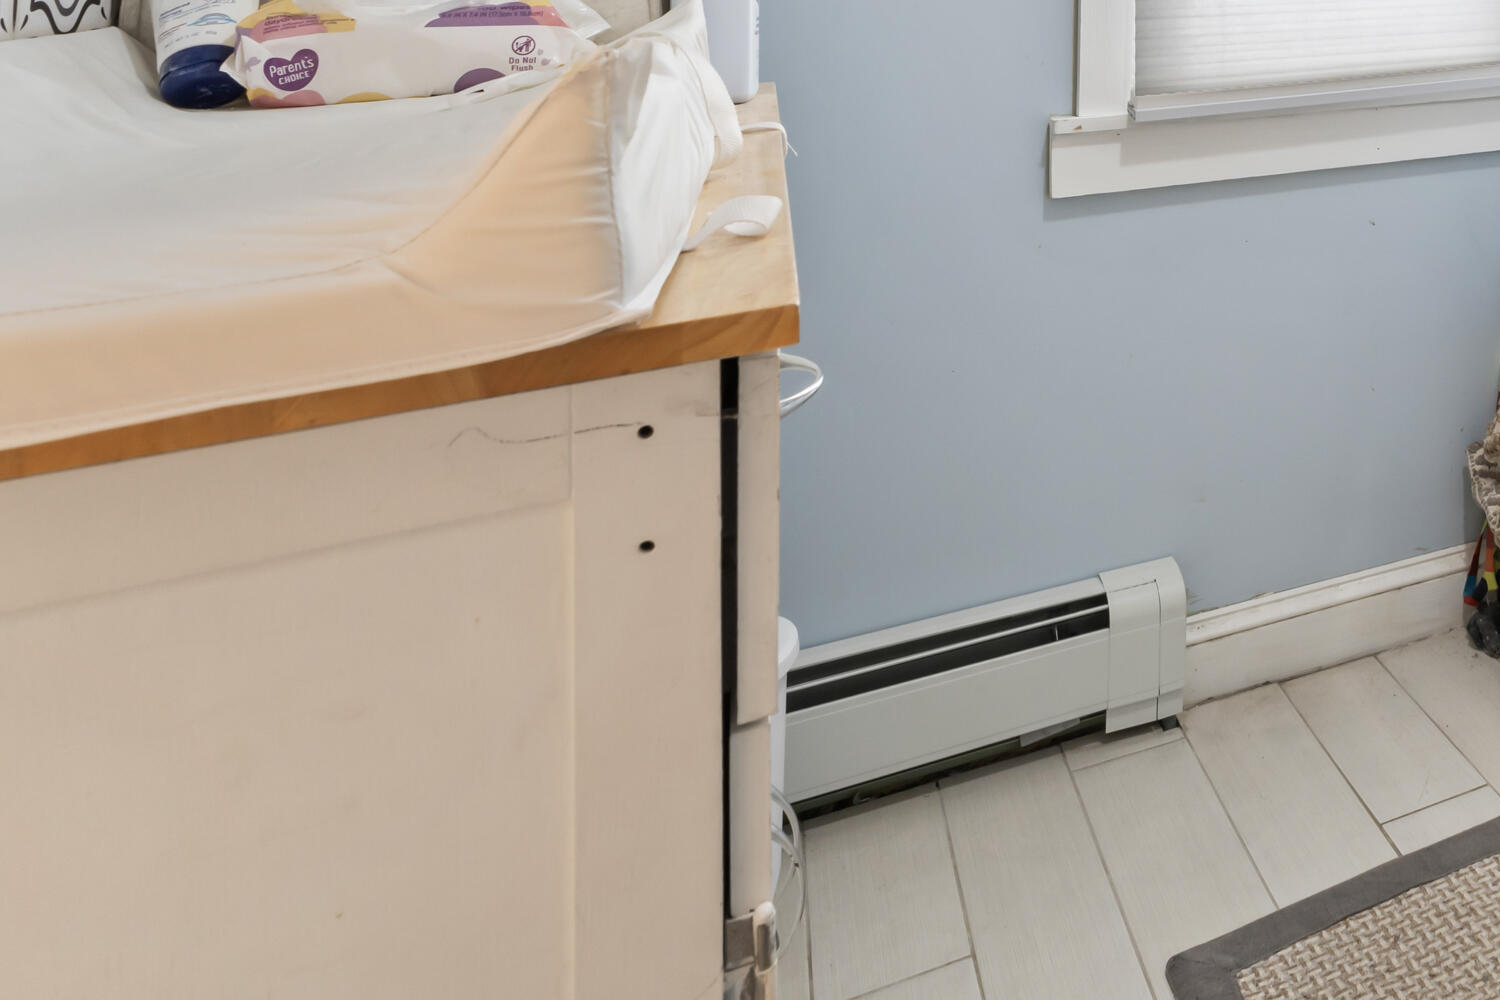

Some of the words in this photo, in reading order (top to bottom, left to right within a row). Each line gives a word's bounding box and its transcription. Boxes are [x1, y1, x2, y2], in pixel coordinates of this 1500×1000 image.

[269, 56, 315, 78] Parent's
[508, 57, 520, 65] Do
[522, 56, 537, 64] Not
[279, 71, 310, 85] CHOICE
